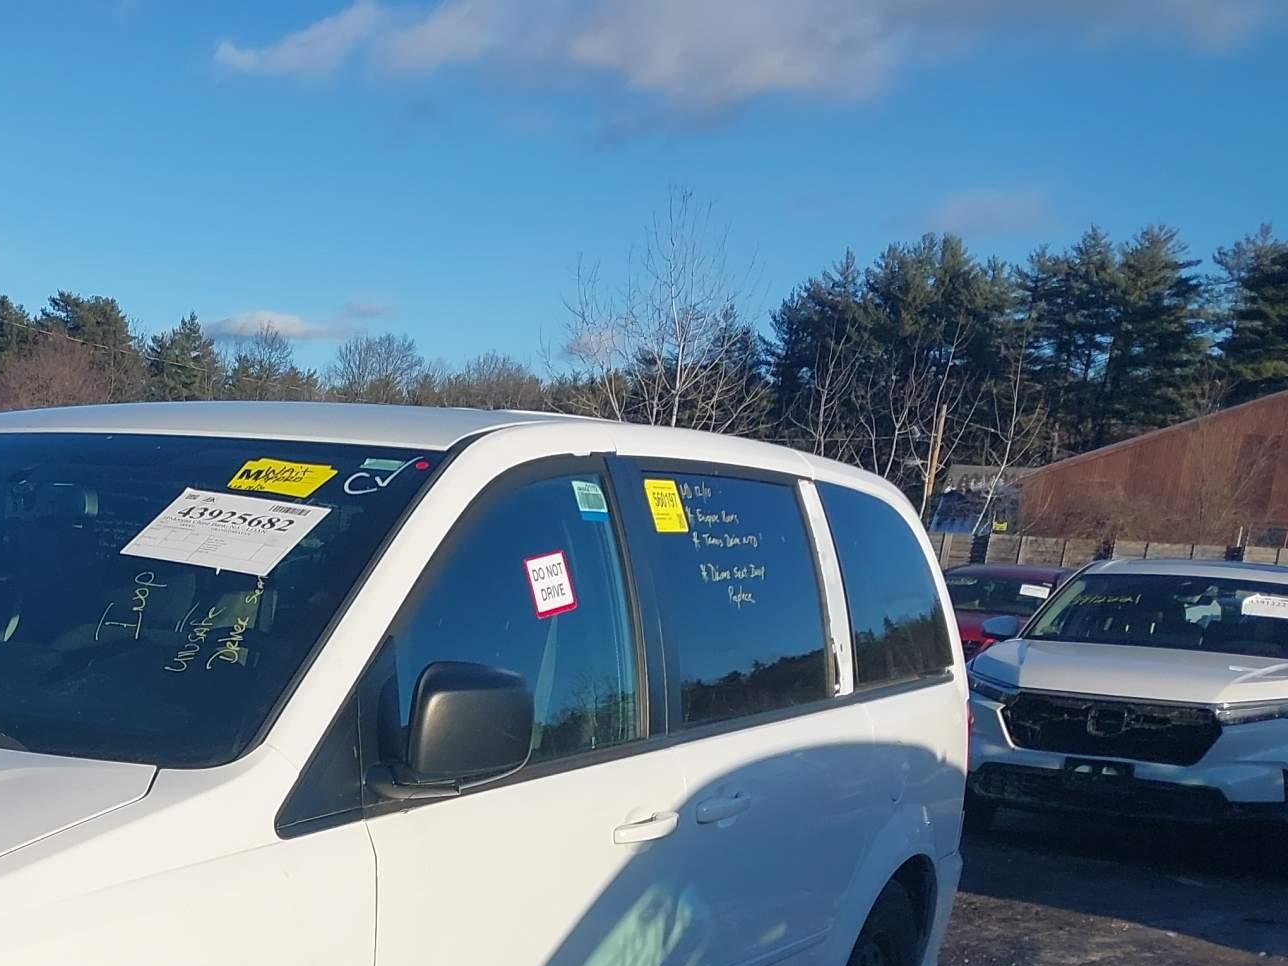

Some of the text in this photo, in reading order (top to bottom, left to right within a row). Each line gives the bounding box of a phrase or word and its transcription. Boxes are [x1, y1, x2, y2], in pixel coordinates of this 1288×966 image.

[178, 505, 296, 532] 43925682
[532, 562, 562, 583] DO NOT
[540, 583, 566, 602] DRIVE
